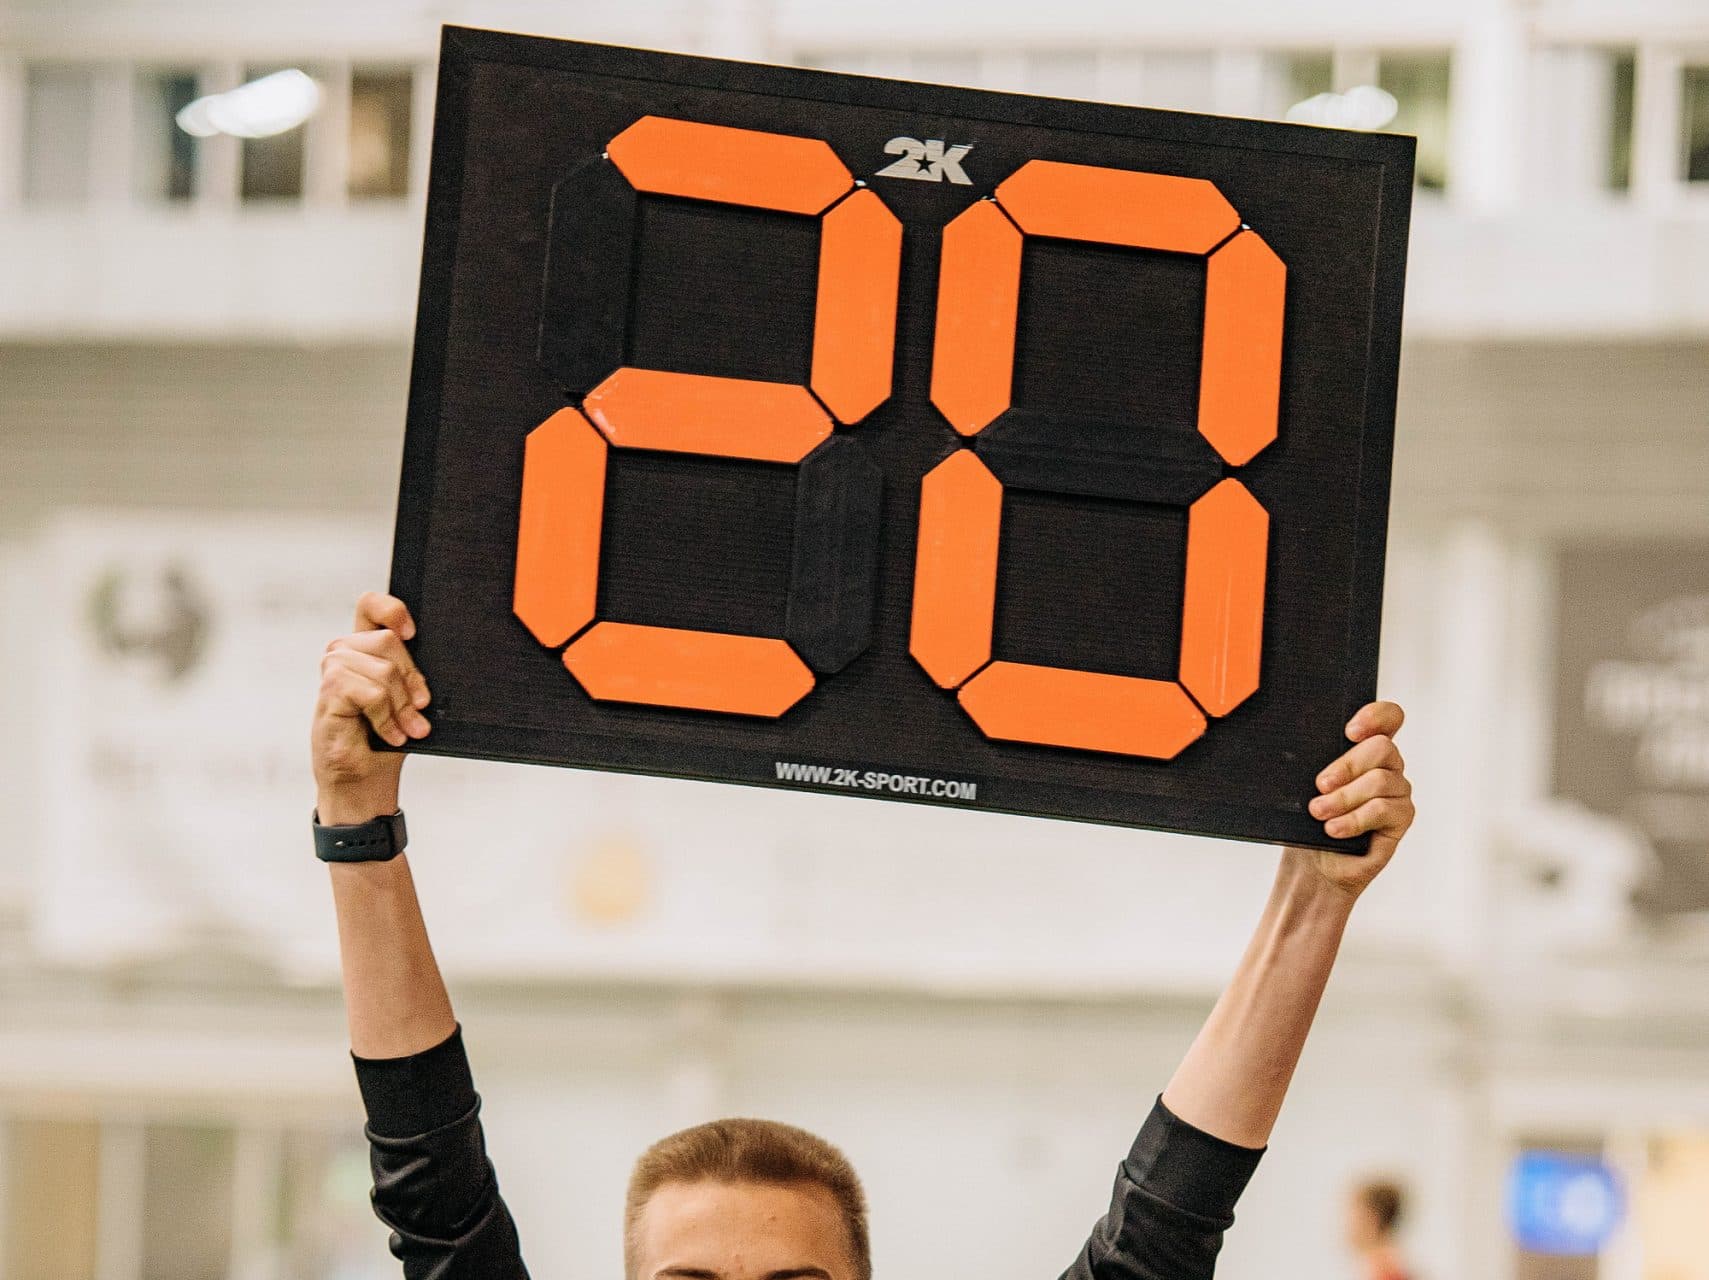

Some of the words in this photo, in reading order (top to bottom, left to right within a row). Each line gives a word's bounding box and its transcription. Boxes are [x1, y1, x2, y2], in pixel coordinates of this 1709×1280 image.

[874, 136, 974, 186] 2K
[512, 115, 1288, 761] 20
[775, 761, 978, 800] WWW.2K-SPORT.COM
